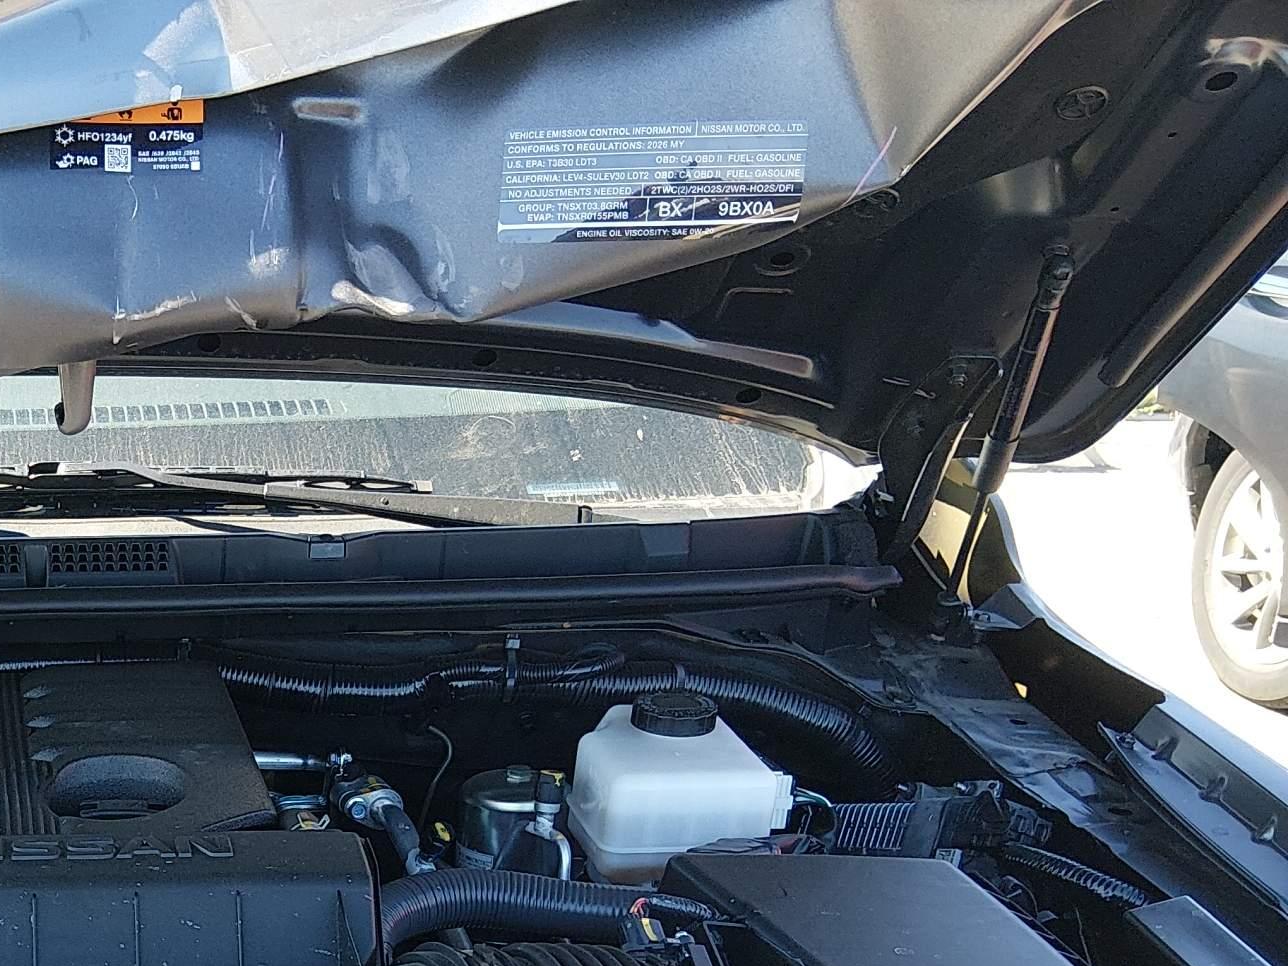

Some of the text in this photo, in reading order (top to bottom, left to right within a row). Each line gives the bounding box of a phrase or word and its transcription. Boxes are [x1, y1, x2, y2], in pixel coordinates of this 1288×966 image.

[510, 126, 692, 140] VEHICLE EMISSION CONTROL INFORMATION
[701, 124, 733, 133] NISSAN
[734, 124, 766, 132] MOTOR
[787, 123, 804, 132] LTD.
[77, 130, 194, 144] HFO1234yf 0.475kg
[508, 140, 685, 154] CONFORMS TO REGULATIONS: 2026 MY
[76, 156, 98, 166] PAG
[656, 156, 678, 164] OBD:
[680, 155, 692, 164] CA
[695, 154, 715, 163] OBD
[728, 153, 802, 162] FUEL: GASOLINE
[506, 158, 597, 168] U.S. EPA: T3B30 LDT3
[506, 172, 648, 184] CALIFORNIA: LEV4-SULEV30 LDT2
[654, 171, 677, 180] OBD:
[678, 170, 691, 178] CA
[694, 170, 714, 178] OBD
[726, 168, 800, 178] FUEL: GASOLINE
[508, 186, 634, 199] NO ADJUSTMENTS NEEDED.
[518, 204, 554, 213] GROUP:
[658, 202, 682, 218] BX
[528, 213, 554, 222] EVAP:
[576, 226, 714, 238] ENGINE OIL VISCOSITY: SAE 0W-20
